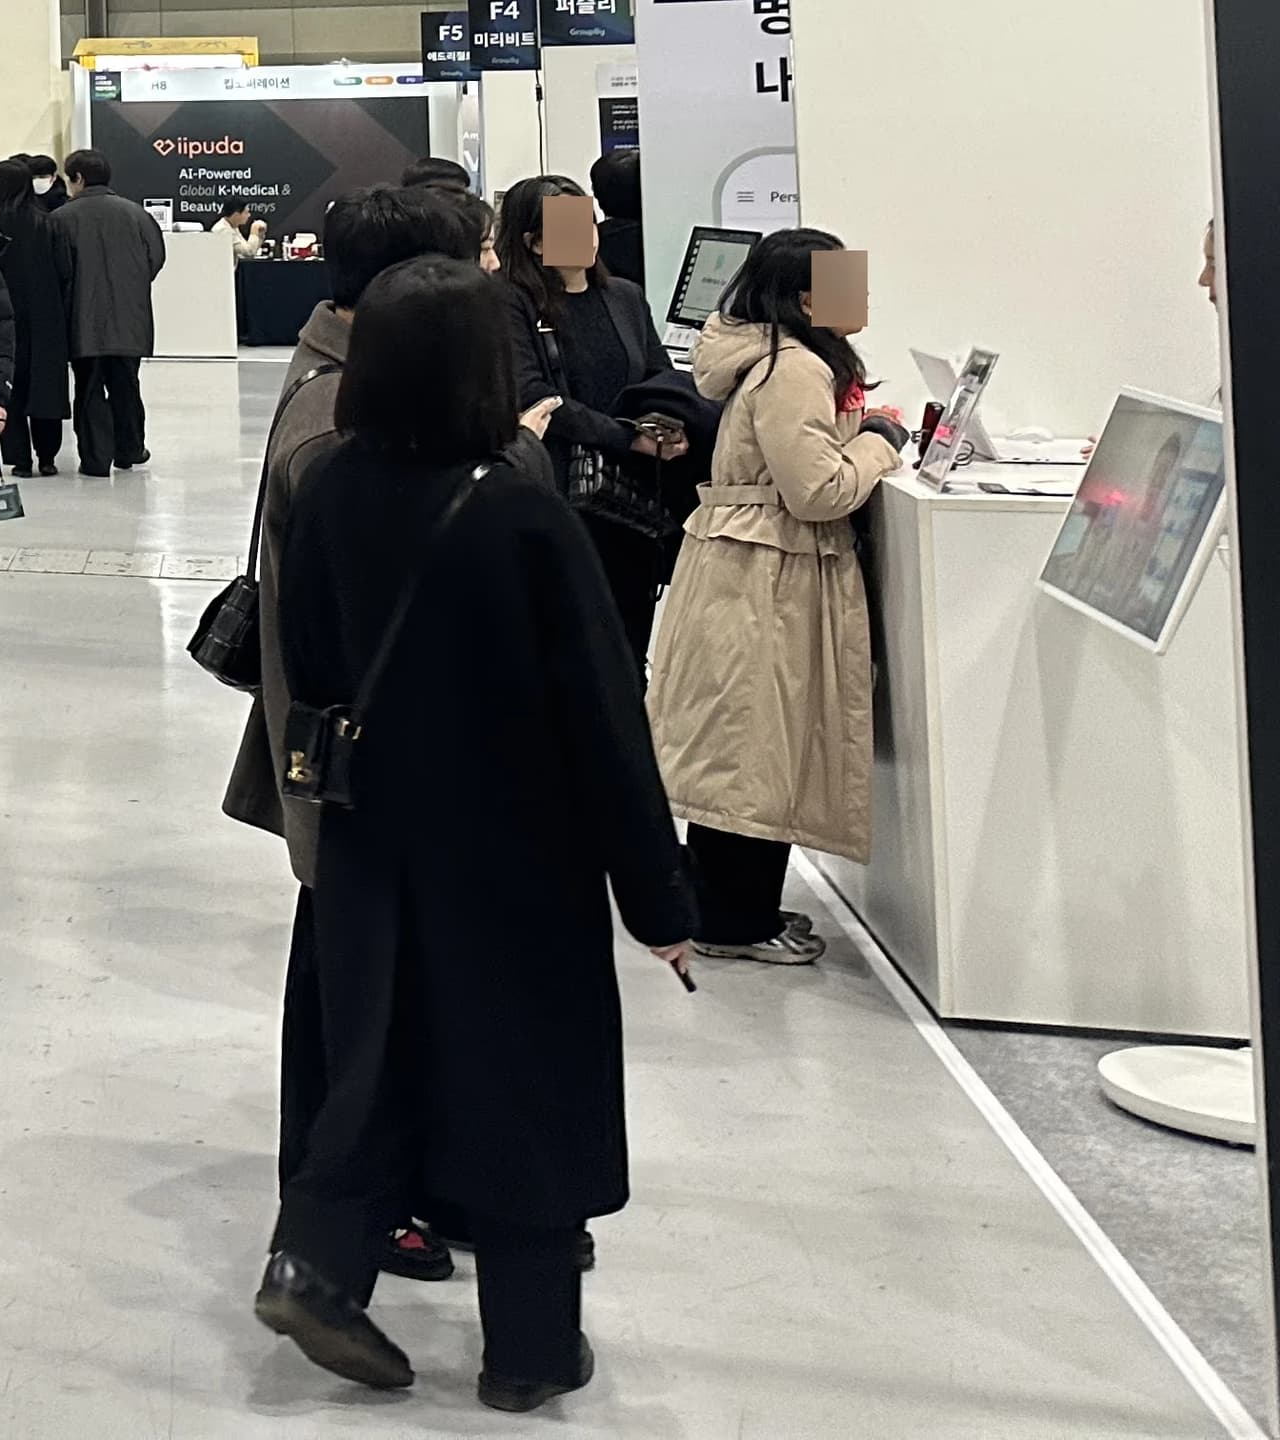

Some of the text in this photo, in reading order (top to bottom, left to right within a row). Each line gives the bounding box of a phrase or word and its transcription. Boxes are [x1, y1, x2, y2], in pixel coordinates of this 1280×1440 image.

[489, 0, 520, 20] F4
[439, 24, 463, 41] F5
[474, 32, 536, 48] 미리비트
[151, 80, 168, 91] H8
[177, 135, 244, 159] iipuda
[178, 167, 252, 180] AI-Powered
[179, 183, 291, 197] Global K-Medical &
[180, 201, 224, 215] Beauty
